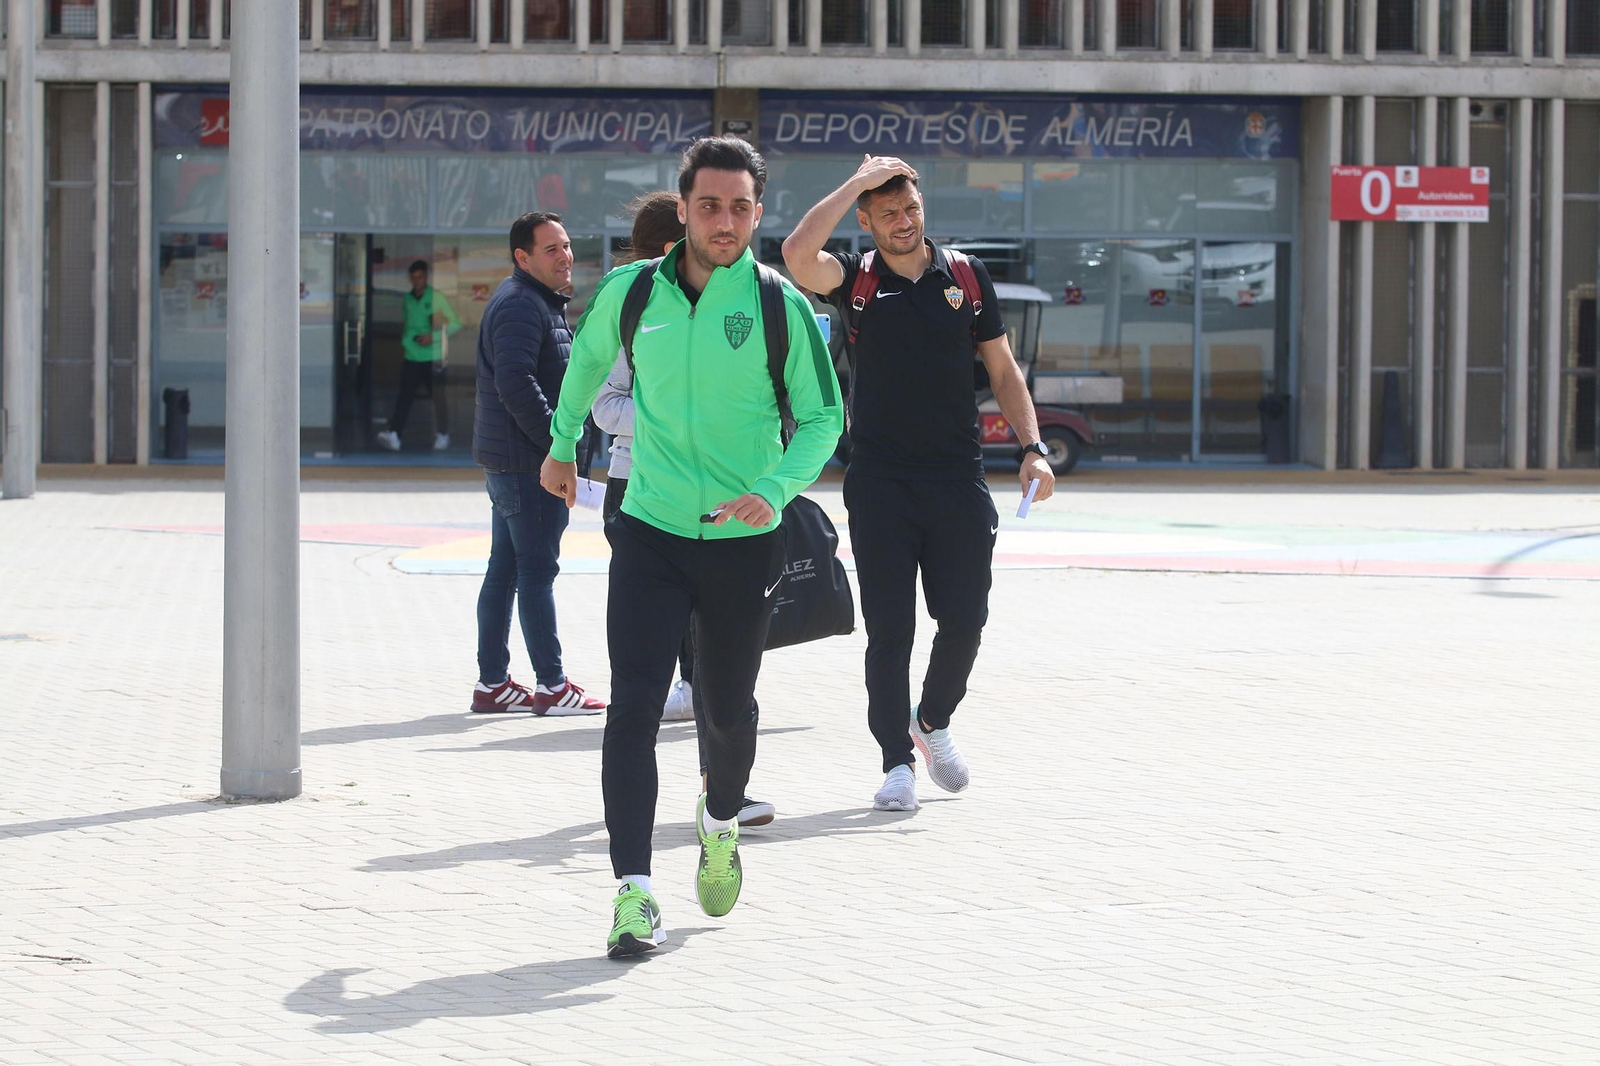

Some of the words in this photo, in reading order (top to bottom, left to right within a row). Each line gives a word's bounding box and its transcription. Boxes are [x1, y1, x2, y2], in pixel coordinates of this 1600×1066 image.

[299, 108, 491, 141] PATRONATO
[511, 111, 690, 142] MUNICIPAL
[775, 112, 967, 145] DEPORTES
[980, 115, 1027, 146] DE
[1039, 111, 1194, 148] ALMERÍA
[1332, 168, 1362, 177] Puerta
[1360, 170, 1392, 215] 0
[1417, 191, 1475, 201] Autoridades
